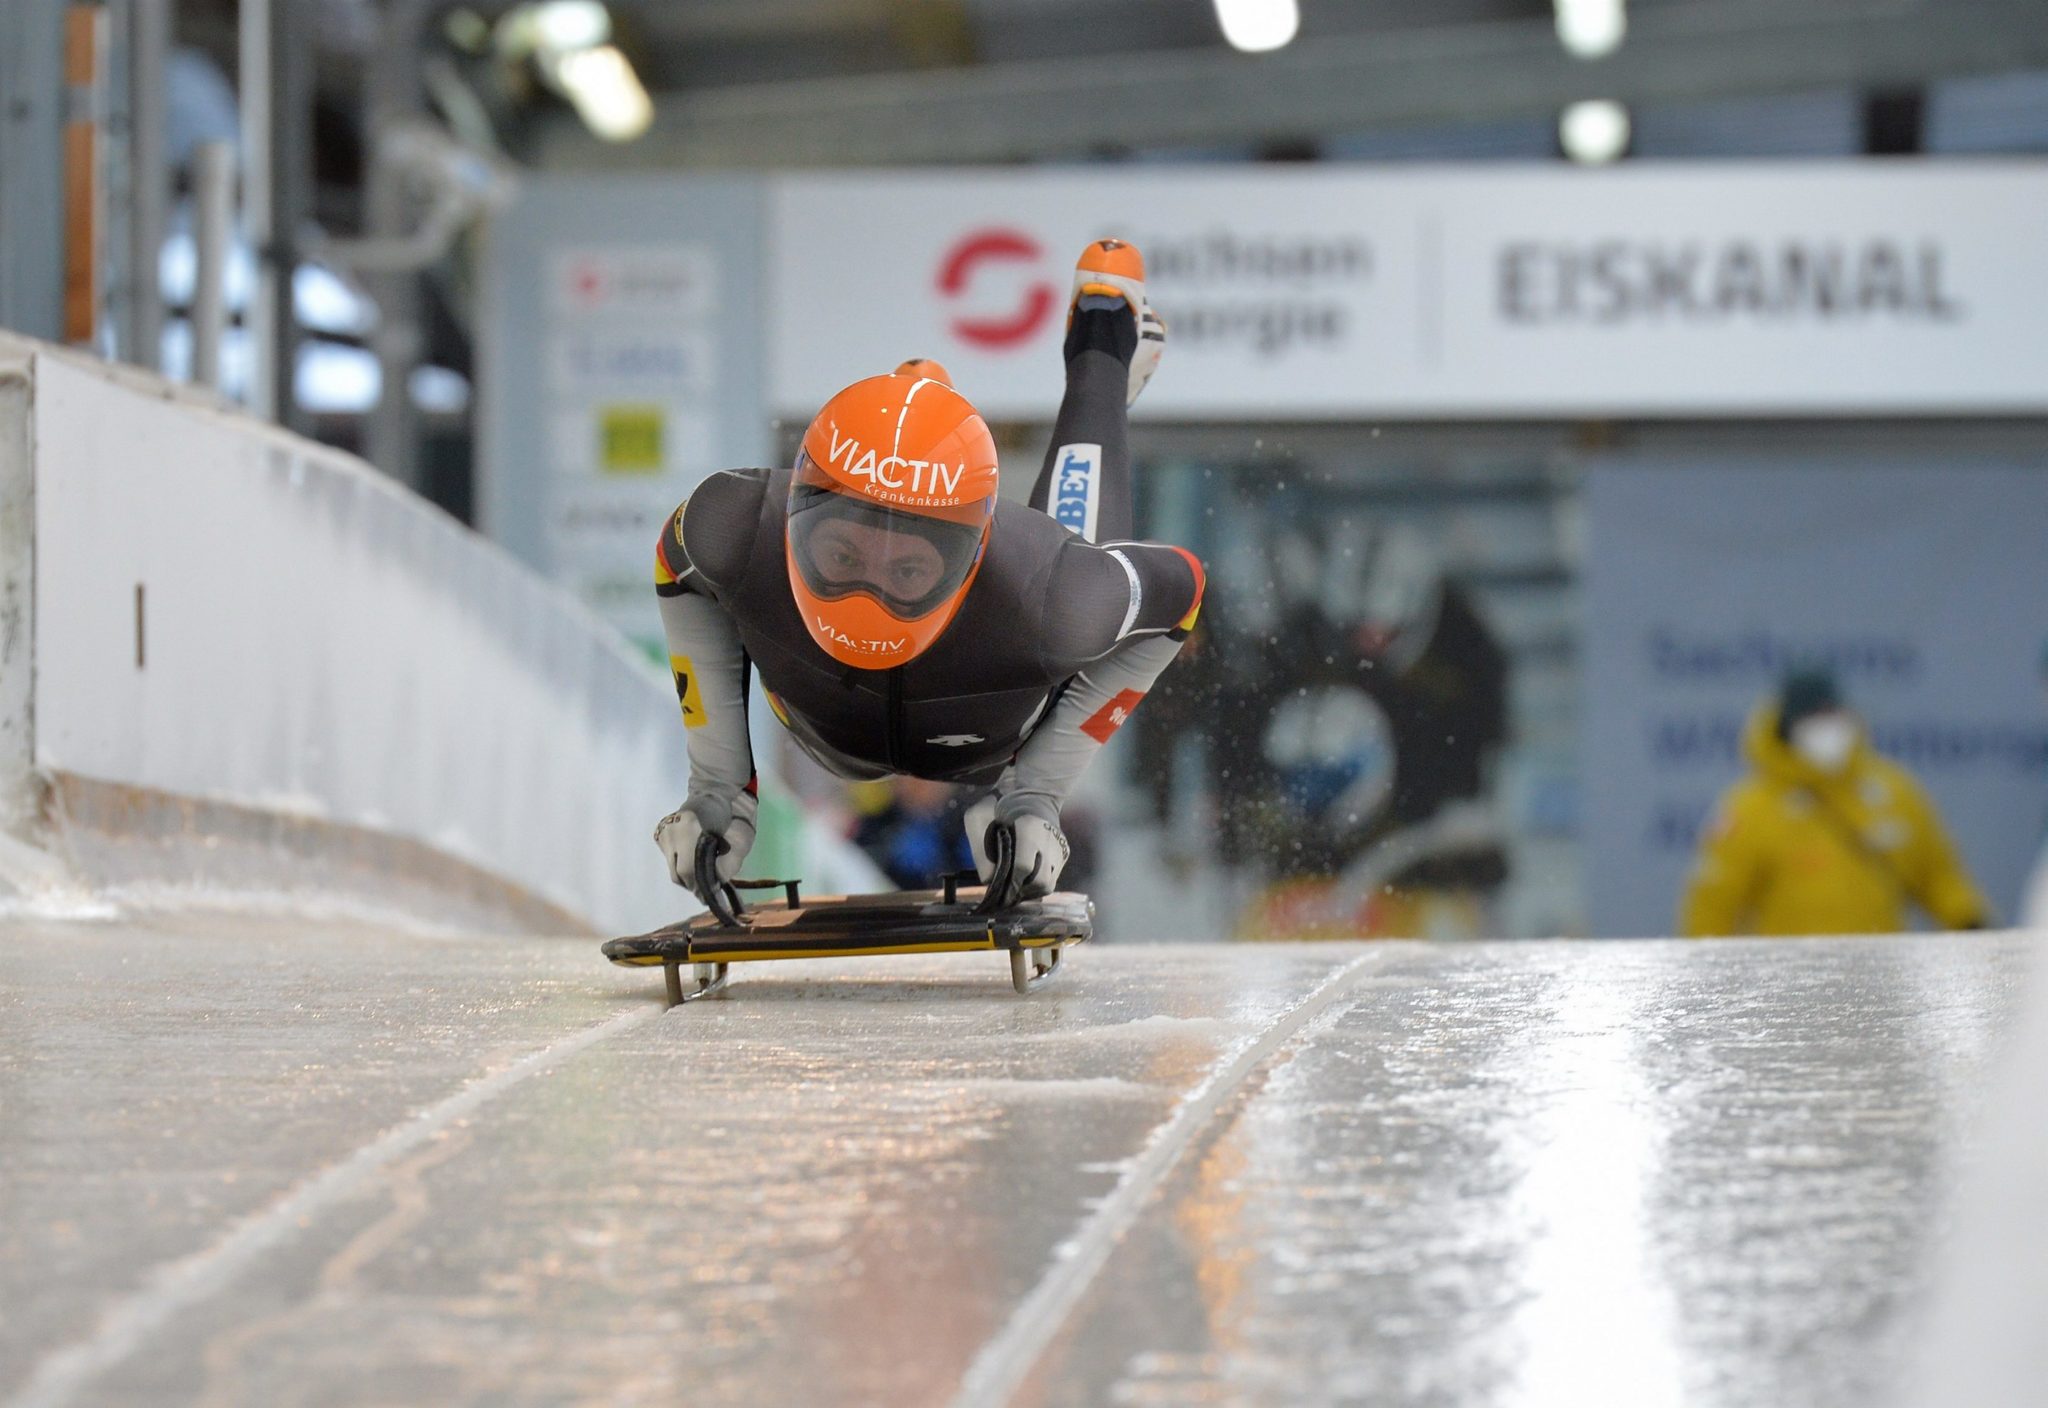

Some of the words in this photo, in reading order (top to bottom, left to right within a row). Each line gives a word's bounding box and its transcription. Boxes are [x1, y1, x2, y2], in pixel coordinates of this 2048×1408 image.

[1100, 224, 1373, 280] achsen
[1496, 238, 1962, 326] EISKANAL
[829, 428, 965, 496] VIACTIV
[864, 483, 960, 507] Krankenkasse
[1055, 454, 1091, 539] BET
